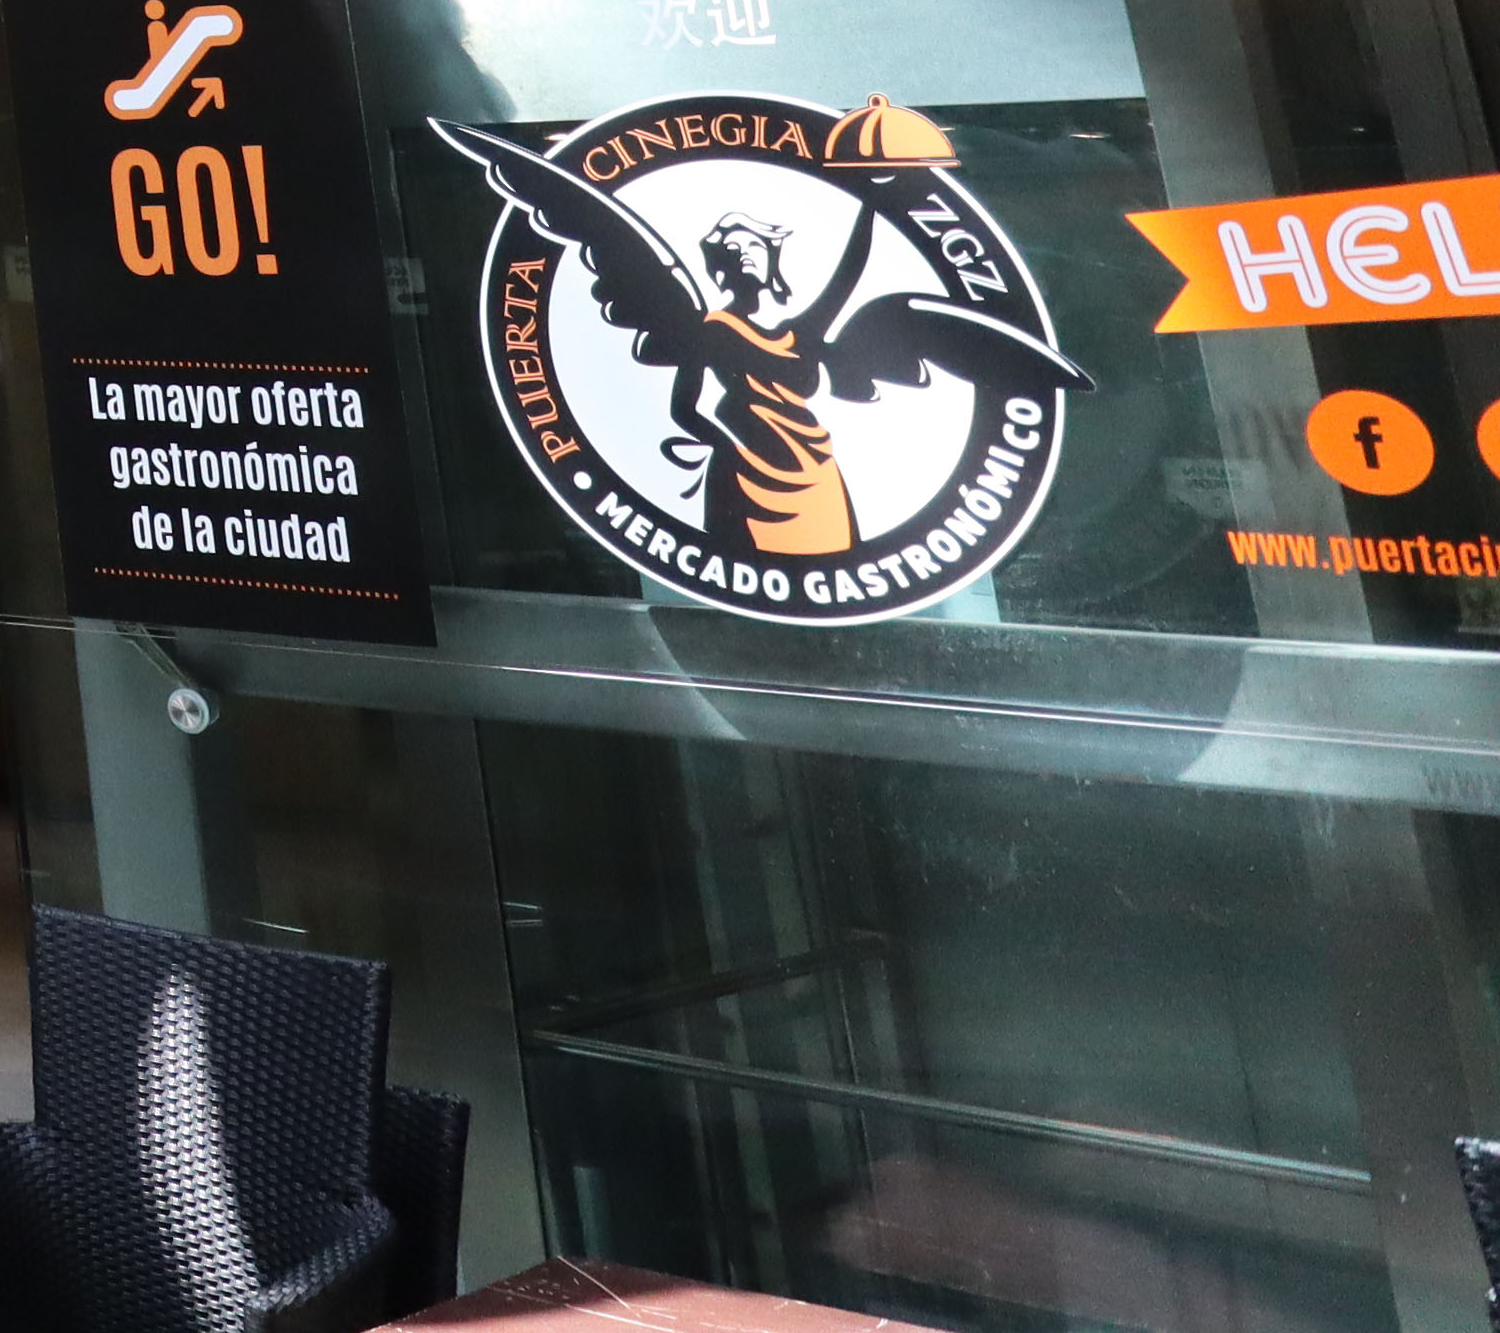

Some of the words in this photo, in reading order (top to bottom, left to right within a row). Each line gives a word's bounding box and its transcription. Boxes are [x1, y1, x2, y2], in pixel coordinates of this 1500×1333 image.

[109, 144, 279, 276] GO!
[582, 113, 815, 182] CINEGIA
[906, 191, 1009, 302] ZGZ
[88, 376, 126, 421] La
[133, 381, 241, 430] mayor
[251, 384, 364, 429] oferta
[502, 257, 581, 462] PUERTA
[109, 441, 358, 496] gastronómica
[131, 505, 173, 551] de
[181, 507, 213, 553] la
[225, 509, 351, 564] ciudad
[594, 498, 791, 601] MERCADO
[803, 396, 1043, 605] GASTRONÓMICO
